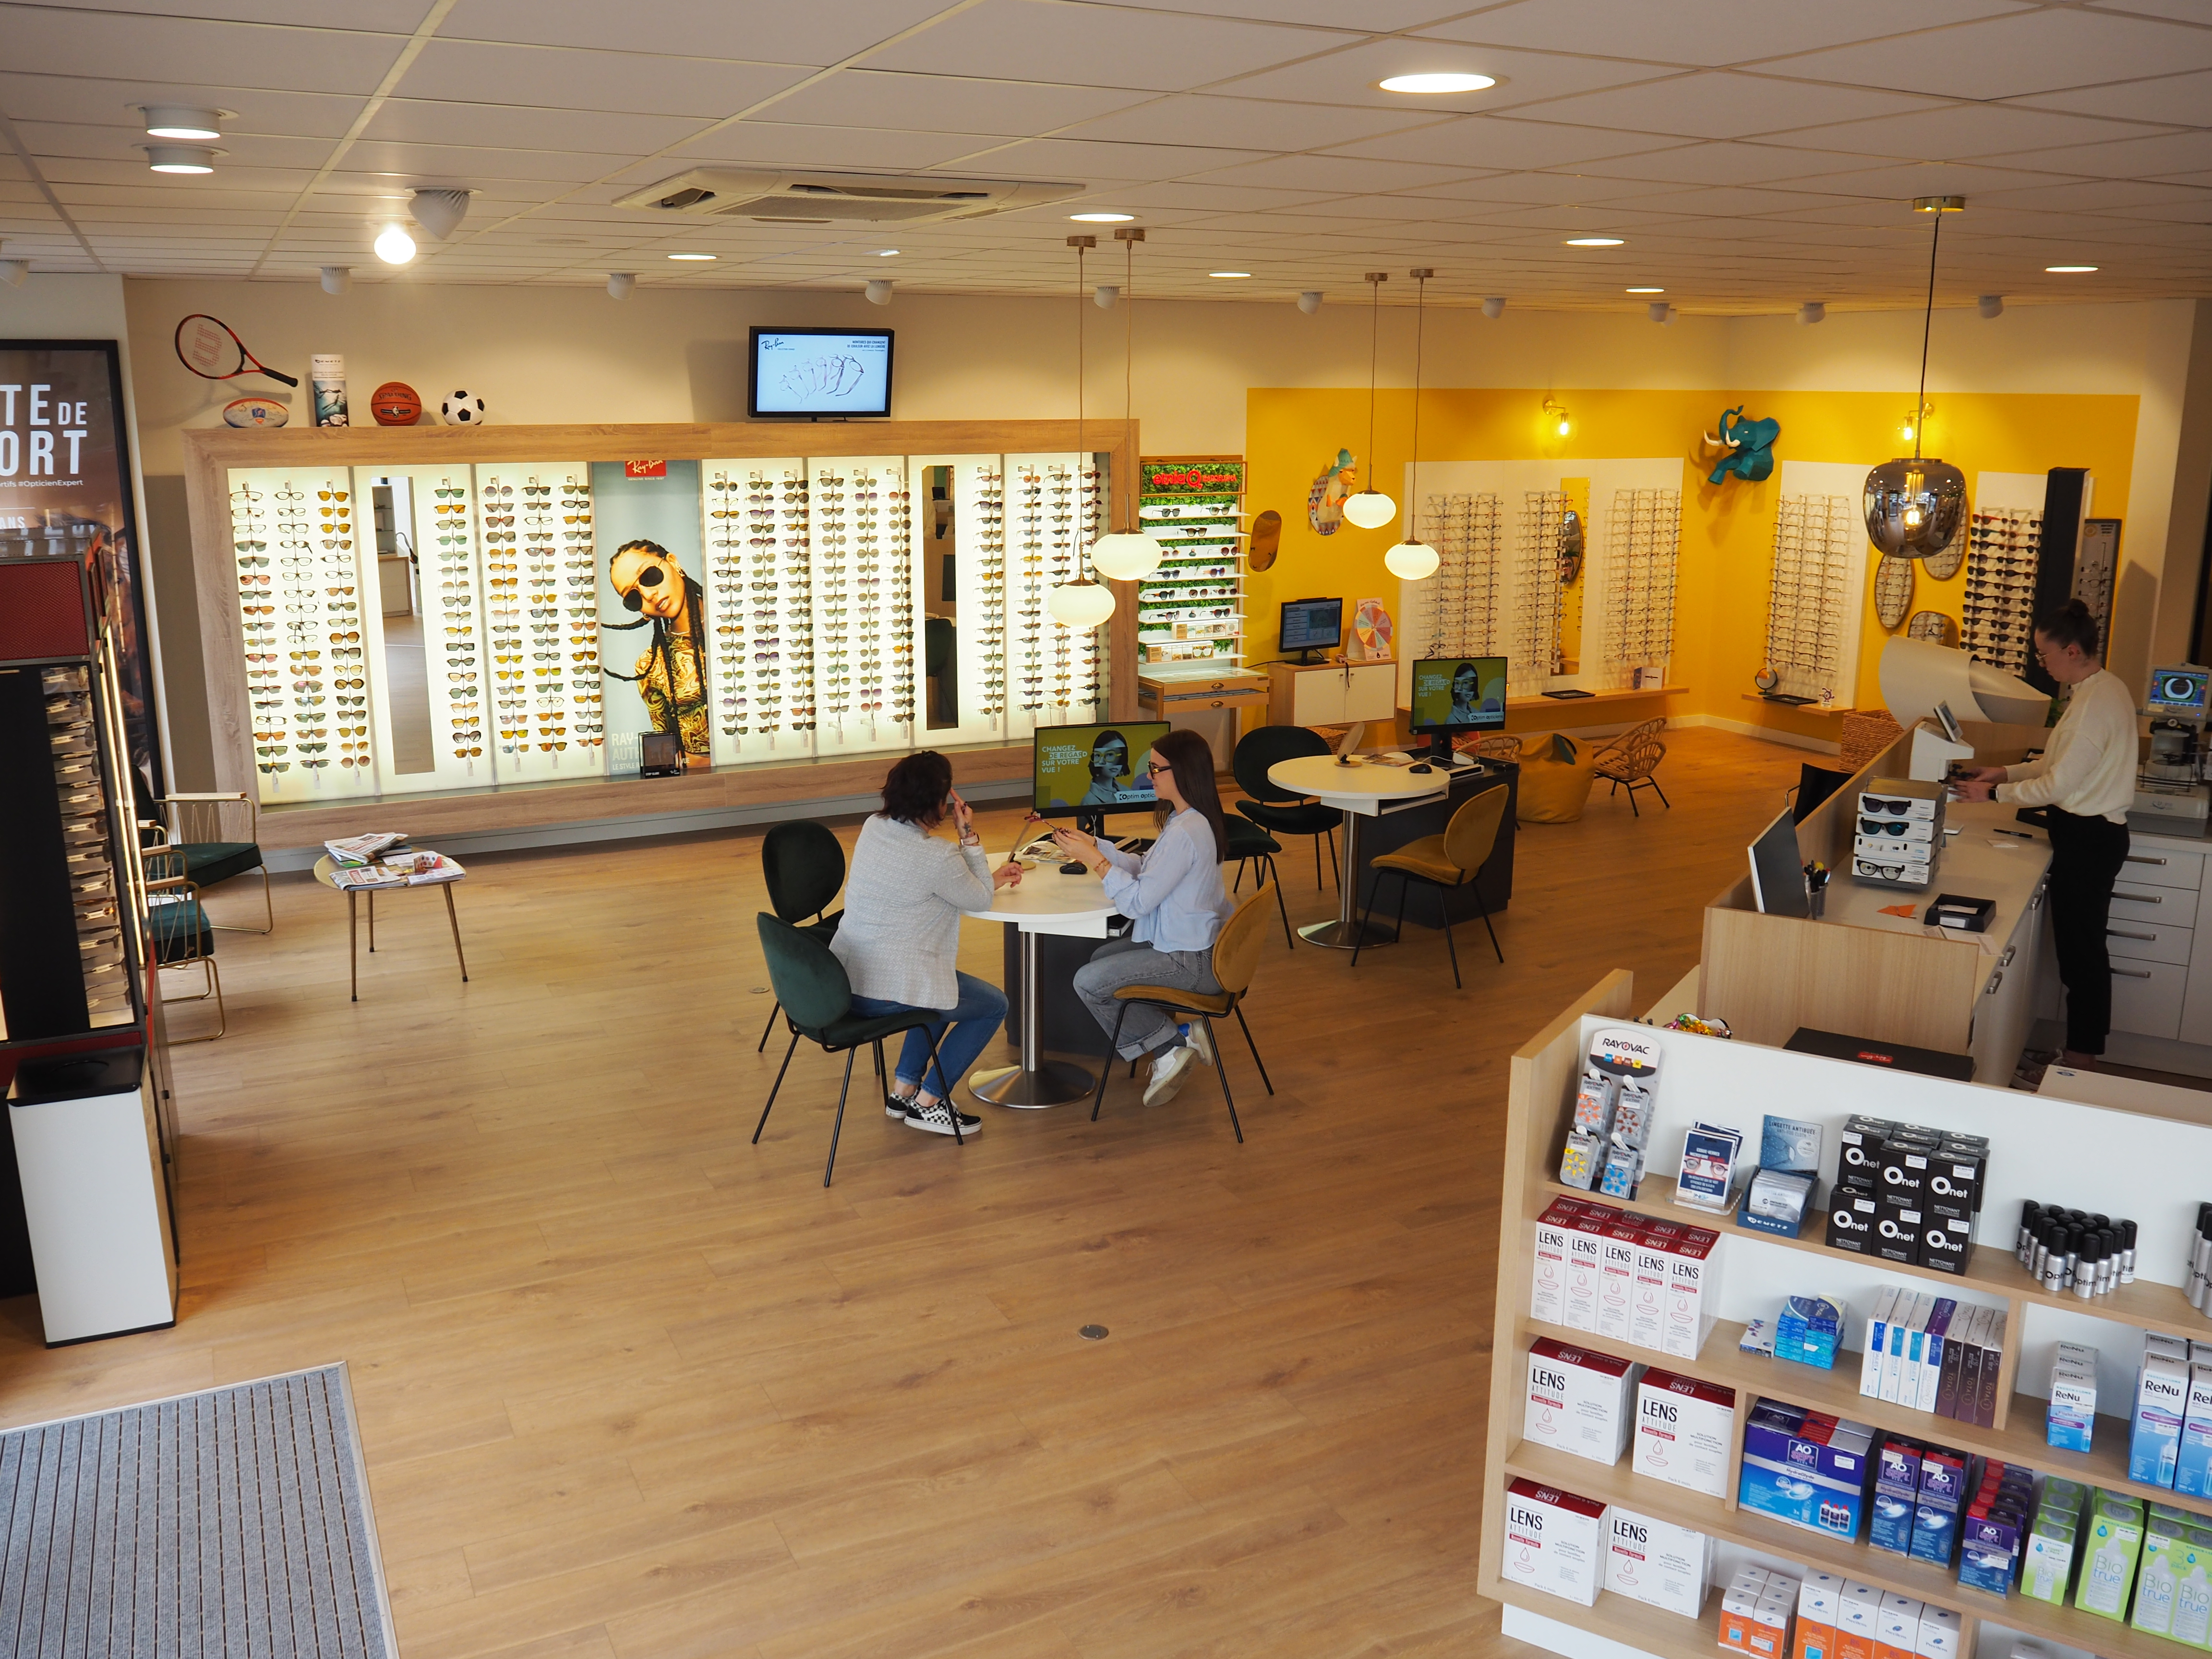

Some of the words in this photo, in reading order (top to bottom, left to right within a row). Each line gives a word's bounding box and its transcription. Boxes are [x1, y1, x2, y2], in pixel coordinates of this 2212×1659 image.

[761, 338, 784, 350] Ray-Ban
[379, 391, 411, 401] SPALDING
[58, 402, 87, 425] DE
[18, 480, 83, 488] #OpticienExpert
[1153, 470, 1186, 485] etnia
[1203, 474, 1237, 482] BARCELONA
[1602, 1038, 1650, 1055] RAYOVAC
[1769, 1121, 1791, 1130] LINGETTE
[1792, 1125, 1815, 1135] ANTIBUÉE
[1846, 1147, 1880, 1169] Onet
[1884, 1166, 1920, 1188] Onet
[1931, 1176, 1968, 1198] Onet
[1934, 1204, 1960, 1213] NETTOYANT
[1833, 1210, 1869, 1232] Onet
[1879, 1220, 1915, 1242] Onet
[1539, 1231, 1563, 1247] LENS
[1926, 1230, 1962, 1252] Onet
[1539, 1244, 1563, 1254] ATTITUDE
[1572, 1238, 1597, 1255] LENS
[1572, 1251, 1596, 1262] ATTITUDE
[1606, 1246, 1631, 1262] LENS
[1605, 1259, 1630, 1270] ATTITUDE
[1639, 1255, 1664, 1271] LENS
[1638, 1268, 1663, 1279] ATTITUDE
[1673, 1263, 1699, 1279] LENS
[1672, 1276, 1698, 1287] ATTITUDE
[2060, 1344, 2084, 1353] ReNu
[1558, 1351, 1583, 1363] LENS
[2059, 1357, 2083, 1366] ReNu
[1533, 1368, 1565, 1391] LENS
[1532, 1384, 1564, 1400] ATTITUDE
[1670, 1382, 1695, 1395] LENS
[2145, 1380, 2179, 1396] ReNu
[2056, 1390, 2080, 1401] ReNu
[1643, 1399, 1677, 1422] LENS
[1642, 1416, 1676, 1432] ATTITUDE
[1795, 1443, 1812, 1454] AO
[1791, 1451, 1815, 1463] SEPT
[1786, 1468, 1815, 1480] HydraGlyde
[1890, 1462, 1907, 1472] AO
[1885, 1468, 1910, 1481] SEPT
[1932, 1473, 1949, 1482] AO
[1928, 1479, 1952, 1493] SEPT
[1536, 1491, 1560, 1504] LENS
[1510, 1507, 1543, 1530] LENS
[1510, 1524, 1541, 1539] ATTITUDE
[1614, 1520, 1647, 1543] LENS
[1983, 1527, 1997, 1535] AO
[1561, 1540, 1579, 1549] SOLUTION
[1613, 1536, 1646, 1552] ATTITUDE
[1666, 1553, 1685, 1561] SOLUTION
[2173, 1550, 2185, 1565] 3
[2094, 1568, 2120, 1584] true
[2143, 1587, 2170, 1603] true
[2179, 1598, 2208, 1614] true
